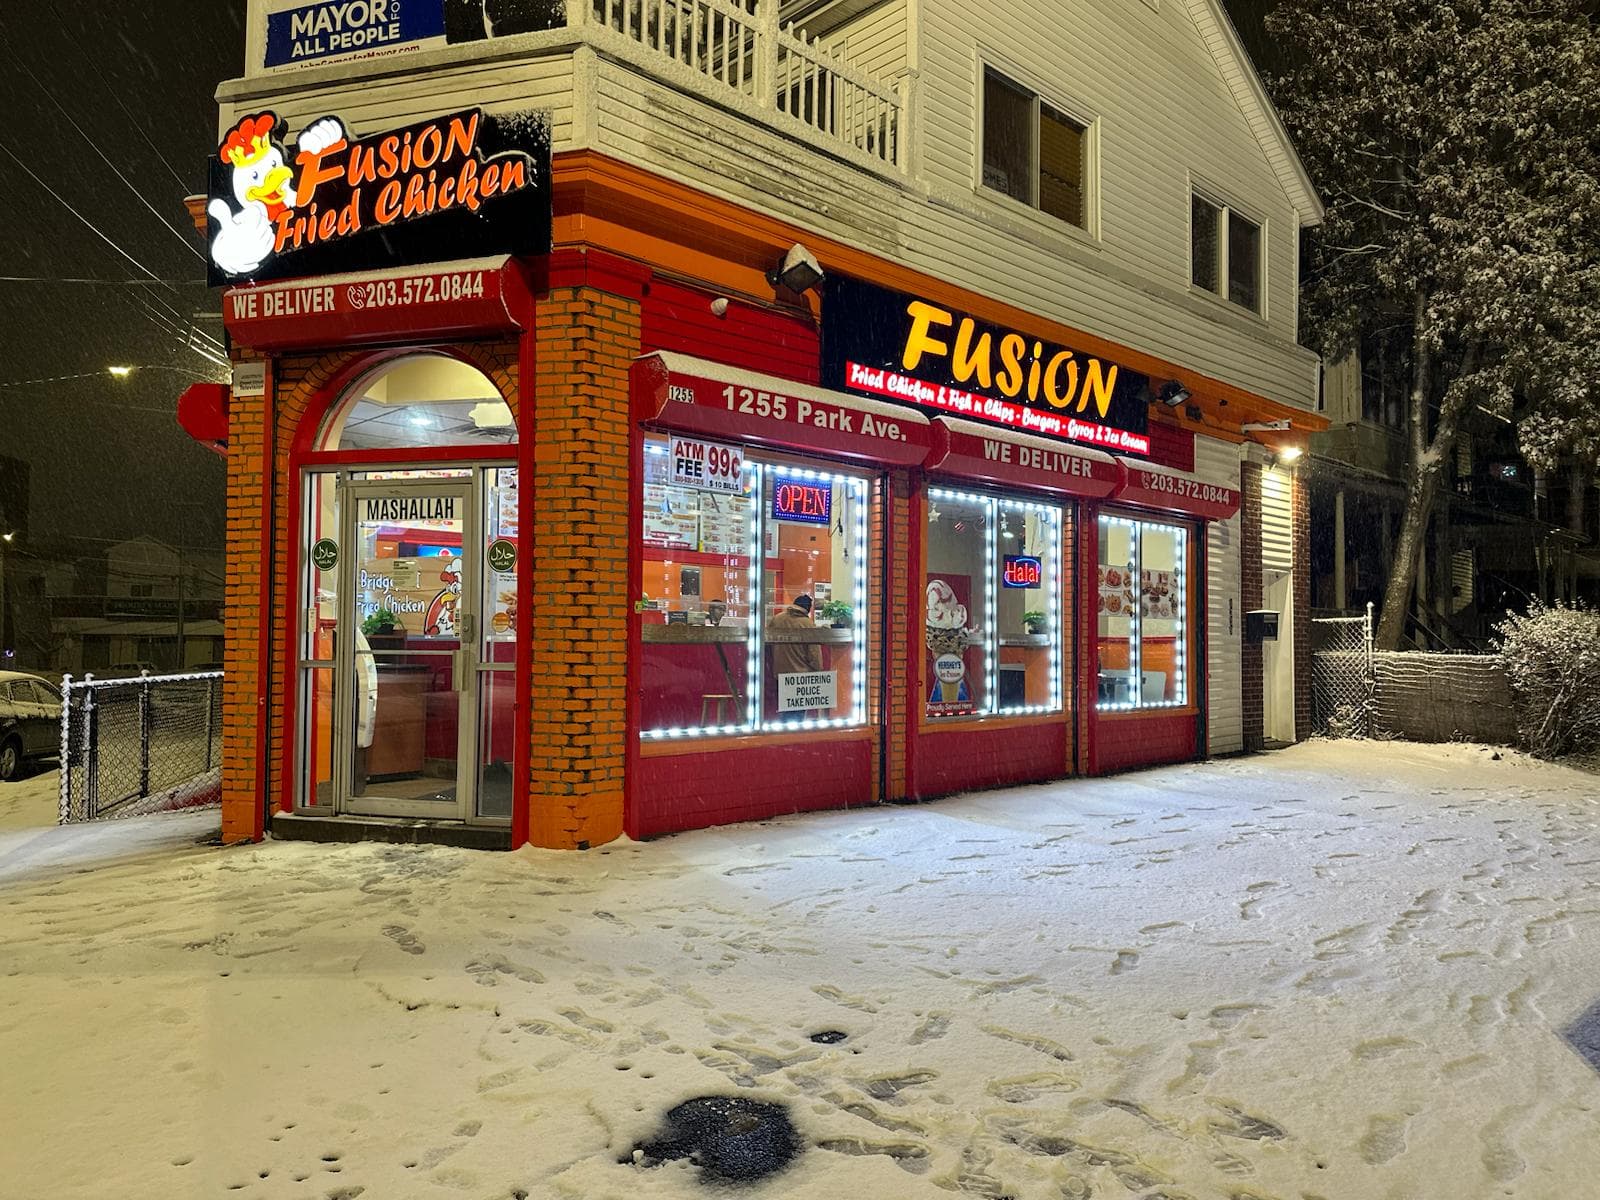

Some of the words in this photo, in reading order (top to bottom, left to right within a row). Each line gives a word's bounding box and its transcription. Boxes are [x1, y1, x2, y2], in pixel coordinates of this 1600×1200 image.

[290, 0, 388, 40] MAYOR
[390, 0, 400, 20] FO
[291, 38, 325, 58] ALL
[330, 23, 400, 50] PEOPLE
[273, 188, 361, 252] Fried
[374, 158, 525, 224] Chicken
[232, 294, 257, 319] WE
[263, 287, 335, 316] DELIVER
[366, 271, 484, 307] 203.572.0844
[670, 386, 693, 402] 1255
[722, 386, 787, 420] 1255
[797, 400, 852, 432] Park
[861, 413, 907, 441] Ave.
[850, 364, 883, 389] Fried
[887, 370, 935, 402] Chicken
[937, 385, 946, 401] &
[948, 389, 973, 410] Fish
[984, 398, 1014, 422] Chips
[1022, 408, 1061, 433] Burgers
[1067, 419, 1094, 440] Gyros
[1096, 424, 1103, 440] &
[1104, 427, 1119, 444] Ice
[1120, 430, 1148, 452] Cream
[675, 441, 704, 460] ATM
[984, 439, 1011, 463] WE
[1019, 446, 1092, 478] DELIVER
[676, 458, 702, 477] FEE
[723, 483, 739, 491] BILLS
[1150, 473, 1230, 505] 203.572.0844
[367, 498, 454, 520] MASHALLAH
[779, 484, 830, 516] OPEN
[490, 547, 515, 561] حلال
[1006, 561, 1039, 583] Halal
[384, 594, 425, 614] Chicken
[785, 676, 795, 685] NO
[796, 675, 831, 685] LOITERING
[796, 686, 821, 696] POLICE
[787, 698, 804, 707] TAKE
[805, 696, 829, 706] NOTICE
